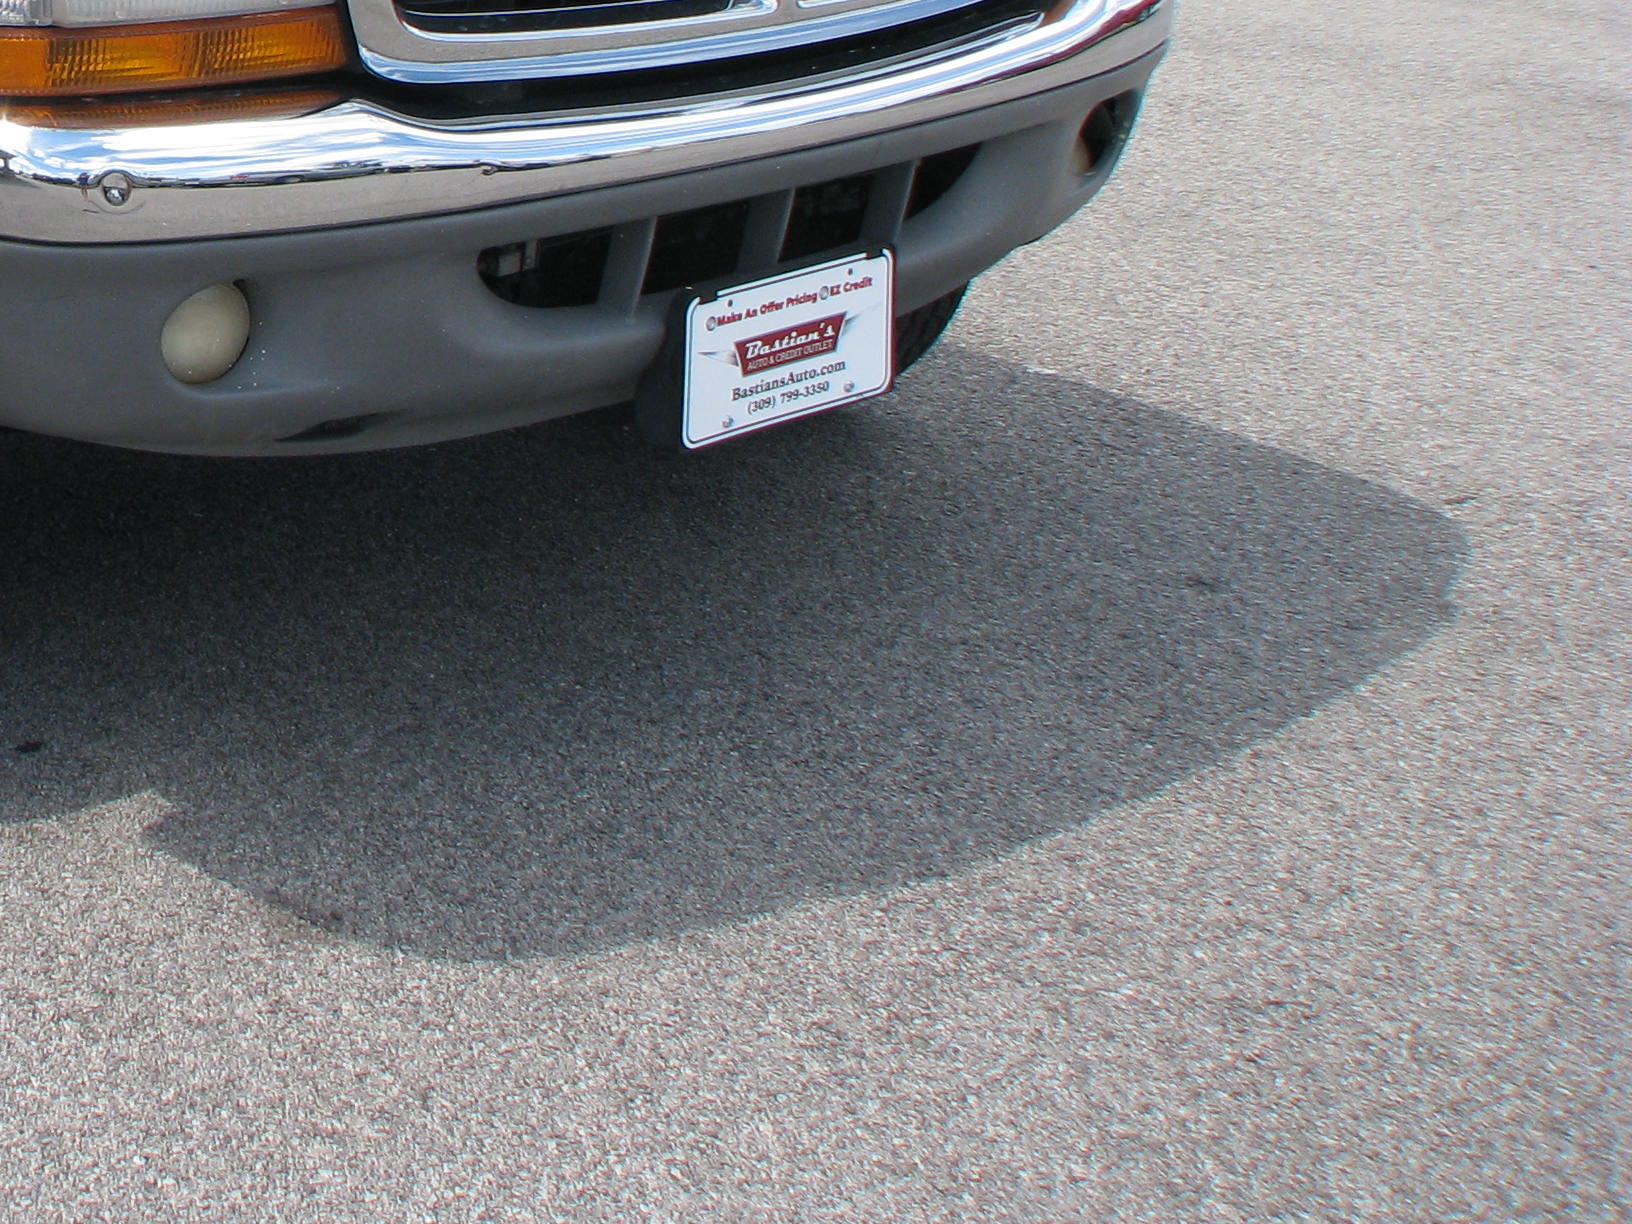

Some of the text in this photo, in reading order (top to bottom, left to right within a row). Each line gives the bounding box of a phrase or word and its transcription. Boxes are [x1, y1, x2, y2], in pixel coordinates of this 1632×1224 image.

[717, 277, 873, 325] Make An Offer Pricing EZ Credit
[745, 323, 835, 359] Bastian's
[775, 348, 803, 362] CREDIT
[803, 340, 833, 354] OUTLET
[732, 361, 846, 401] BastiansAuto.com
[747, 381, 830, 415] (309) 799-3350
